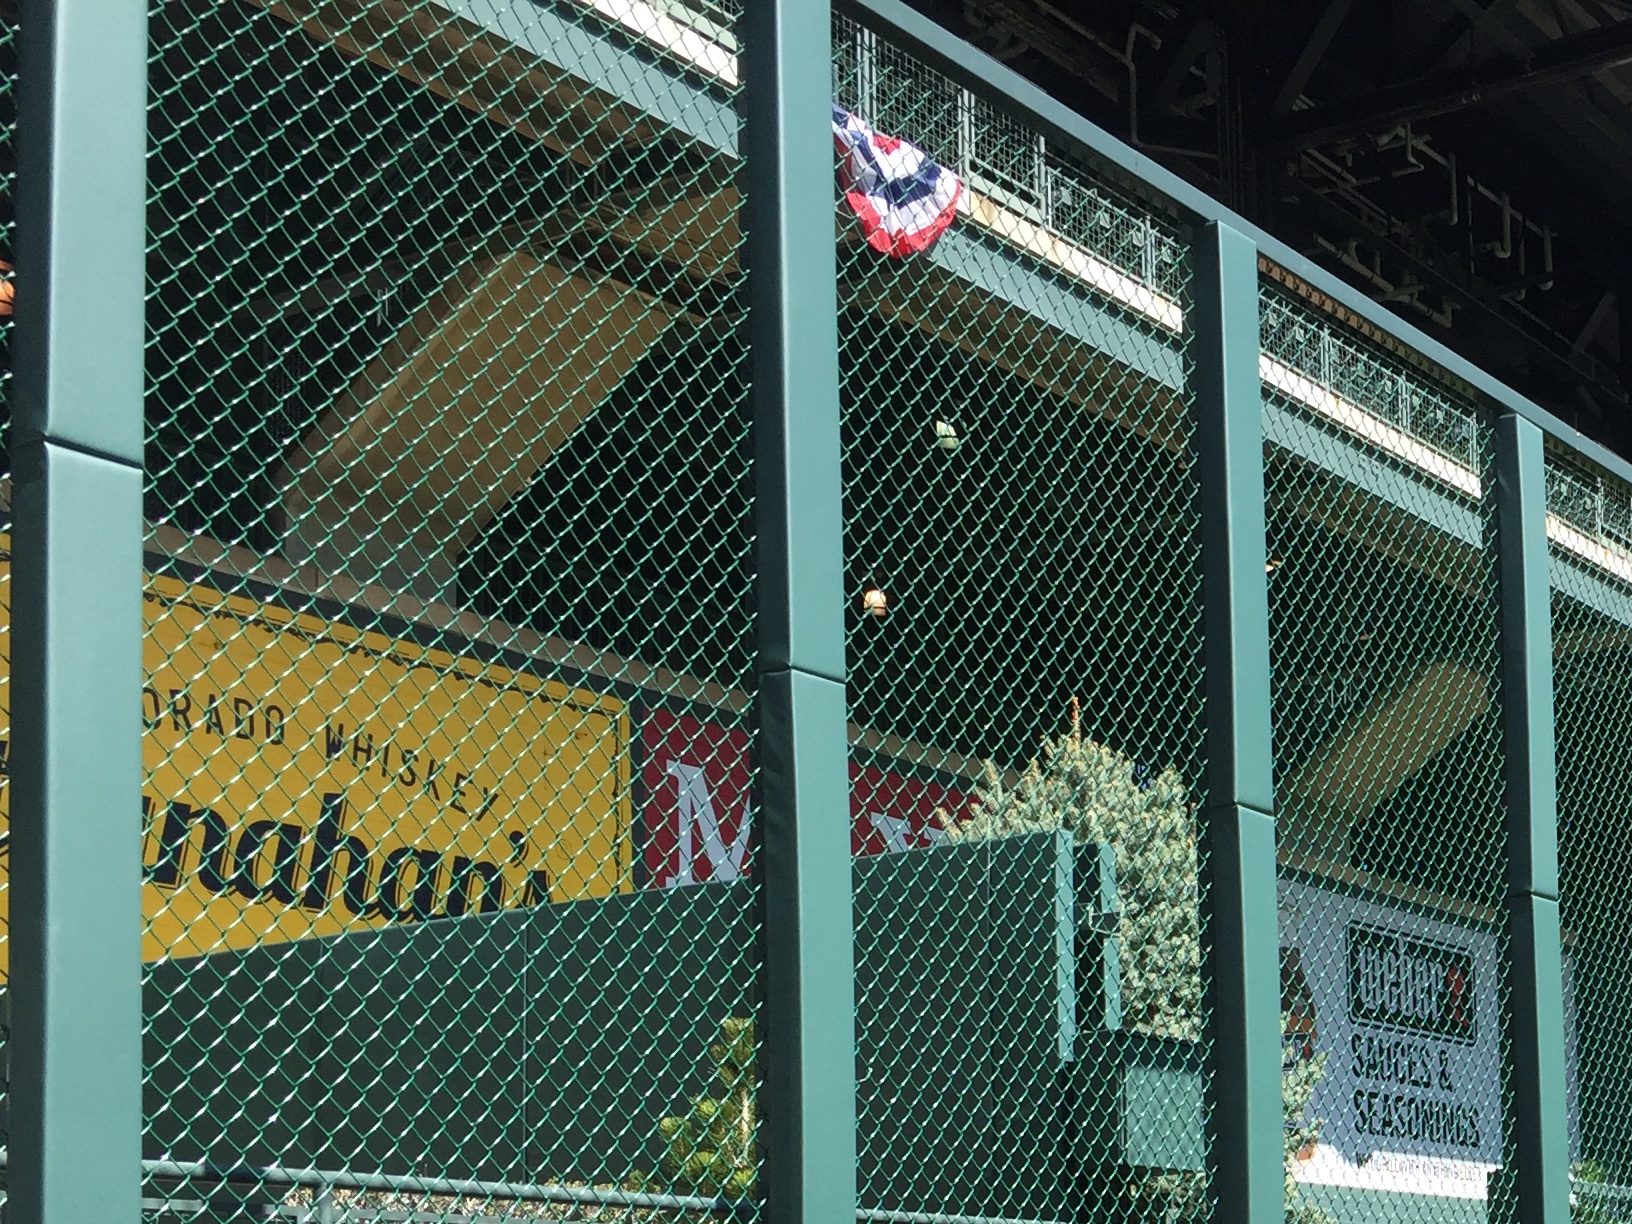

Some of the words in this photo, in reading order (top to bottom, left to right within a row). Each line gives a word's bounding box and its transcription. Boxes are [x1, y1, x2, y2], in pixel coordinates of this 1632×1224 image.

[324, 723, 500, 822] WHISKEY
[1351, 1033, 1432, 1088] SAUCES
[1353, 1089, 1480, 1148] SEASONINGS
